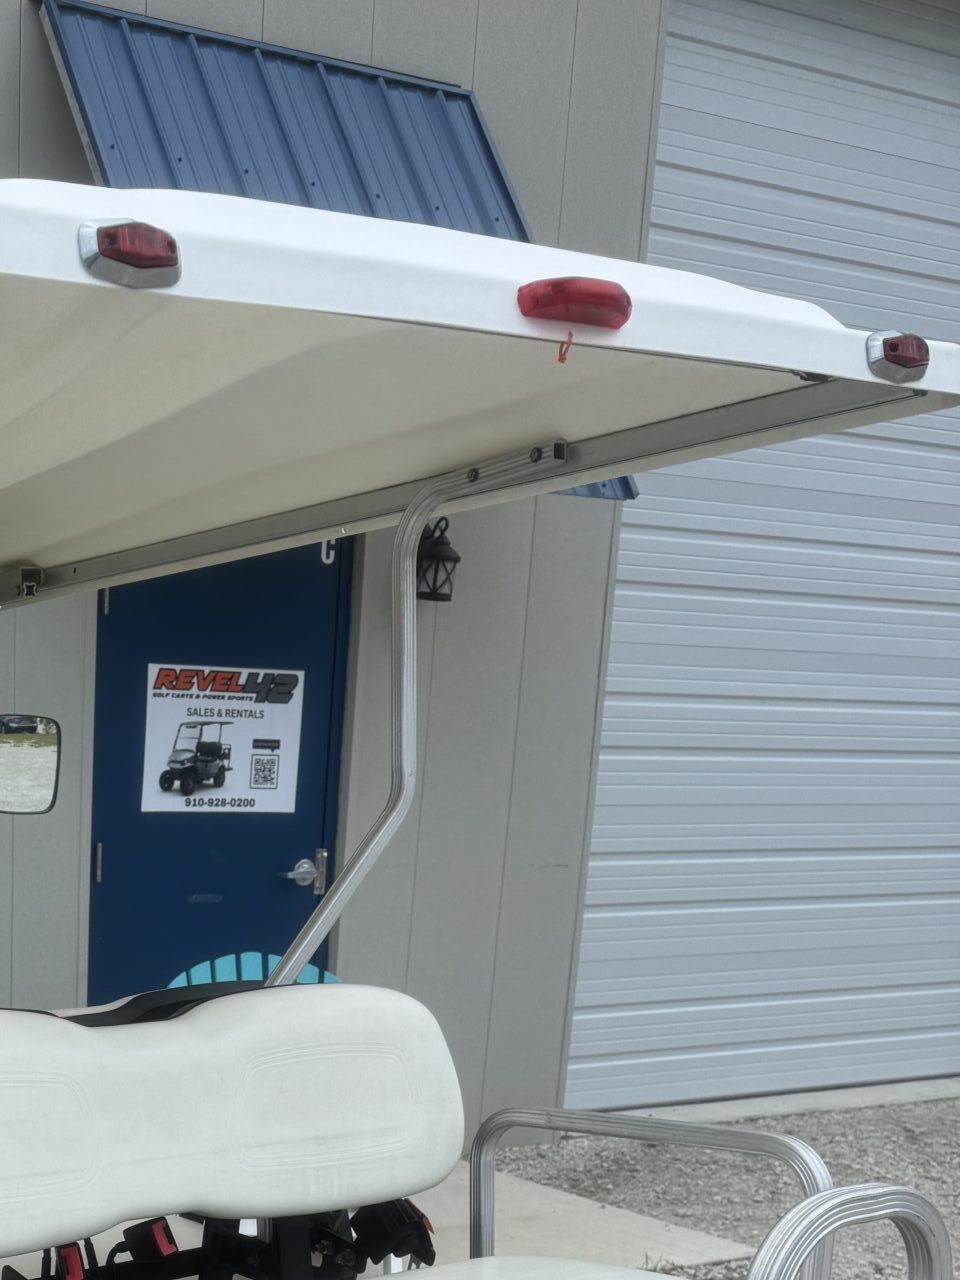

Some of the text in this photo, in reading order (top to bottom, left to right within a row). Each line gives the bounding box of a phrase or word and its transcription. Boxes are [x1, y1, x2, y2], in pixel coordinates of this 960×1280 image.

[187, 707, 265, 719] SALES & RENTALS
[184, 797, 256, 807] 910-928-0200
